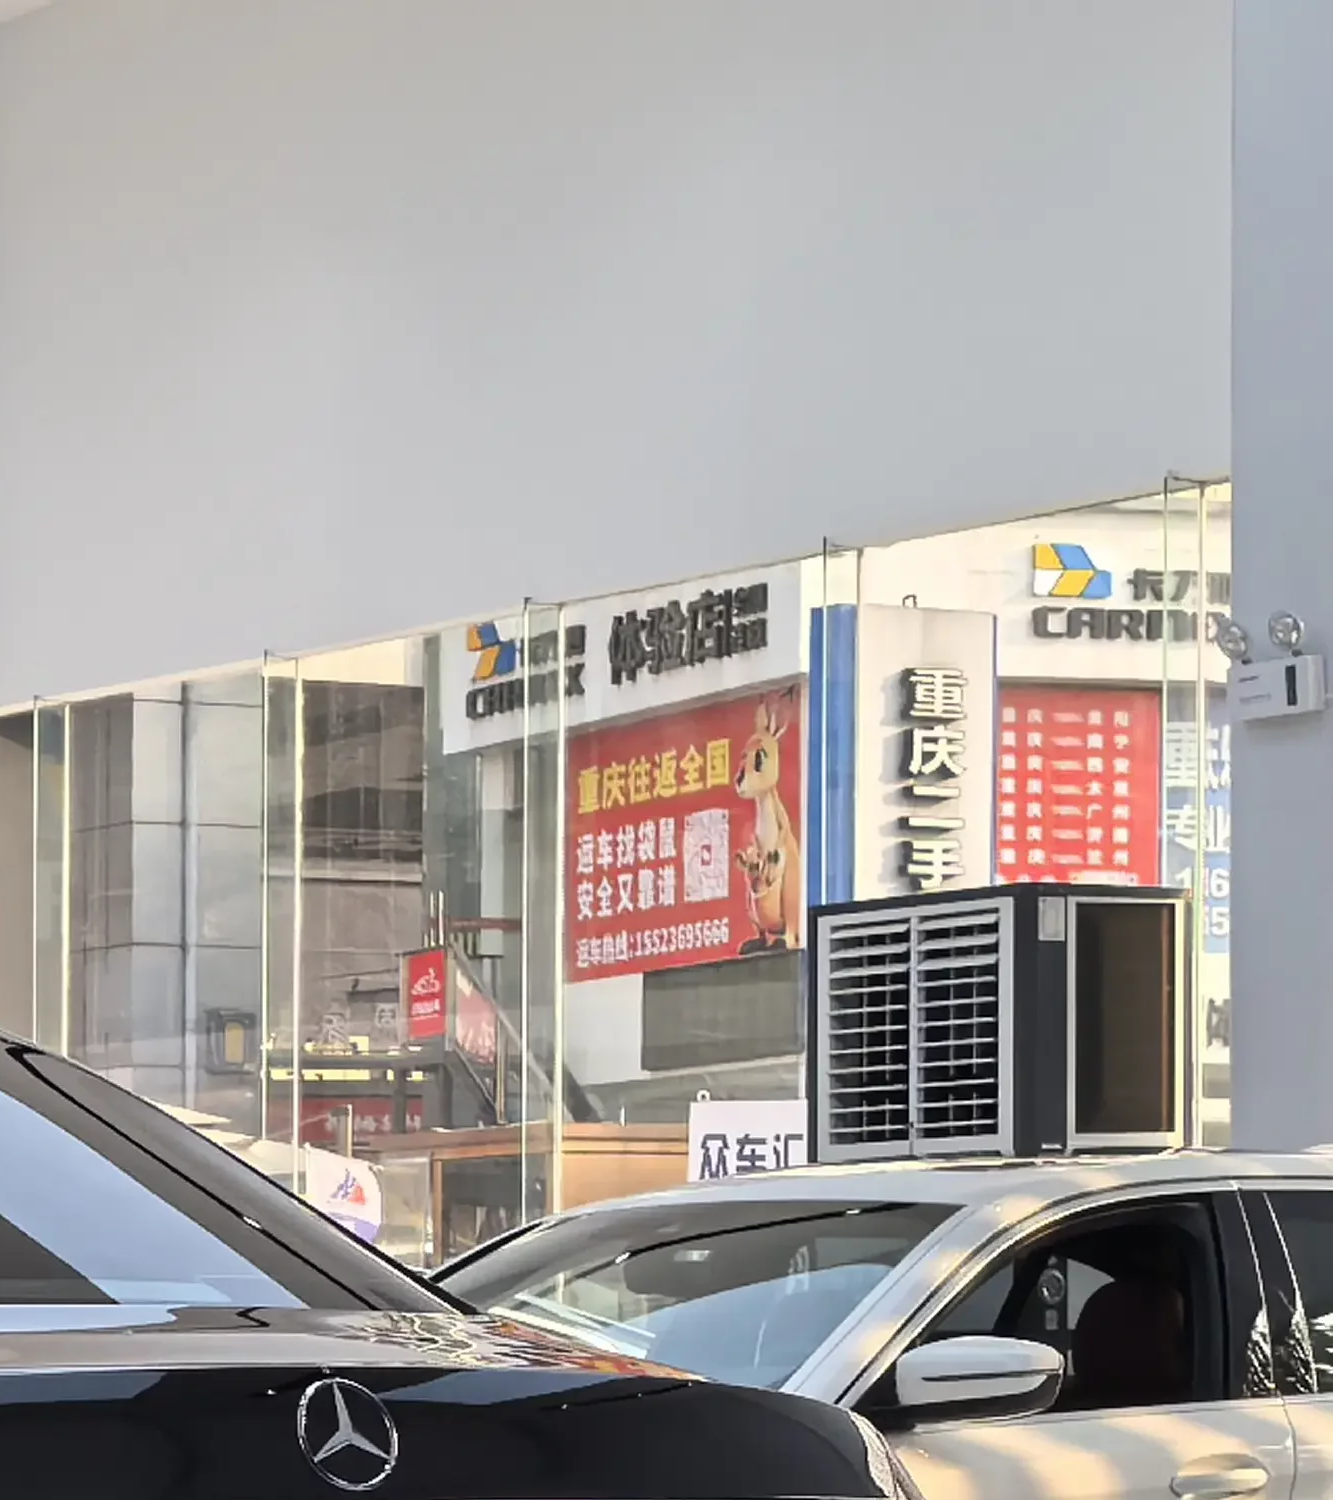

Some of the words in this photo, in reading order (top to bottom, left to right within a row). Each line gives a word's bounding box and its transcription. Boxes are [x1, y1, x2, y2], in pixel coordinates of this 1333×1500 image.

[577, 739, 730, 814] 重庆往返全国
